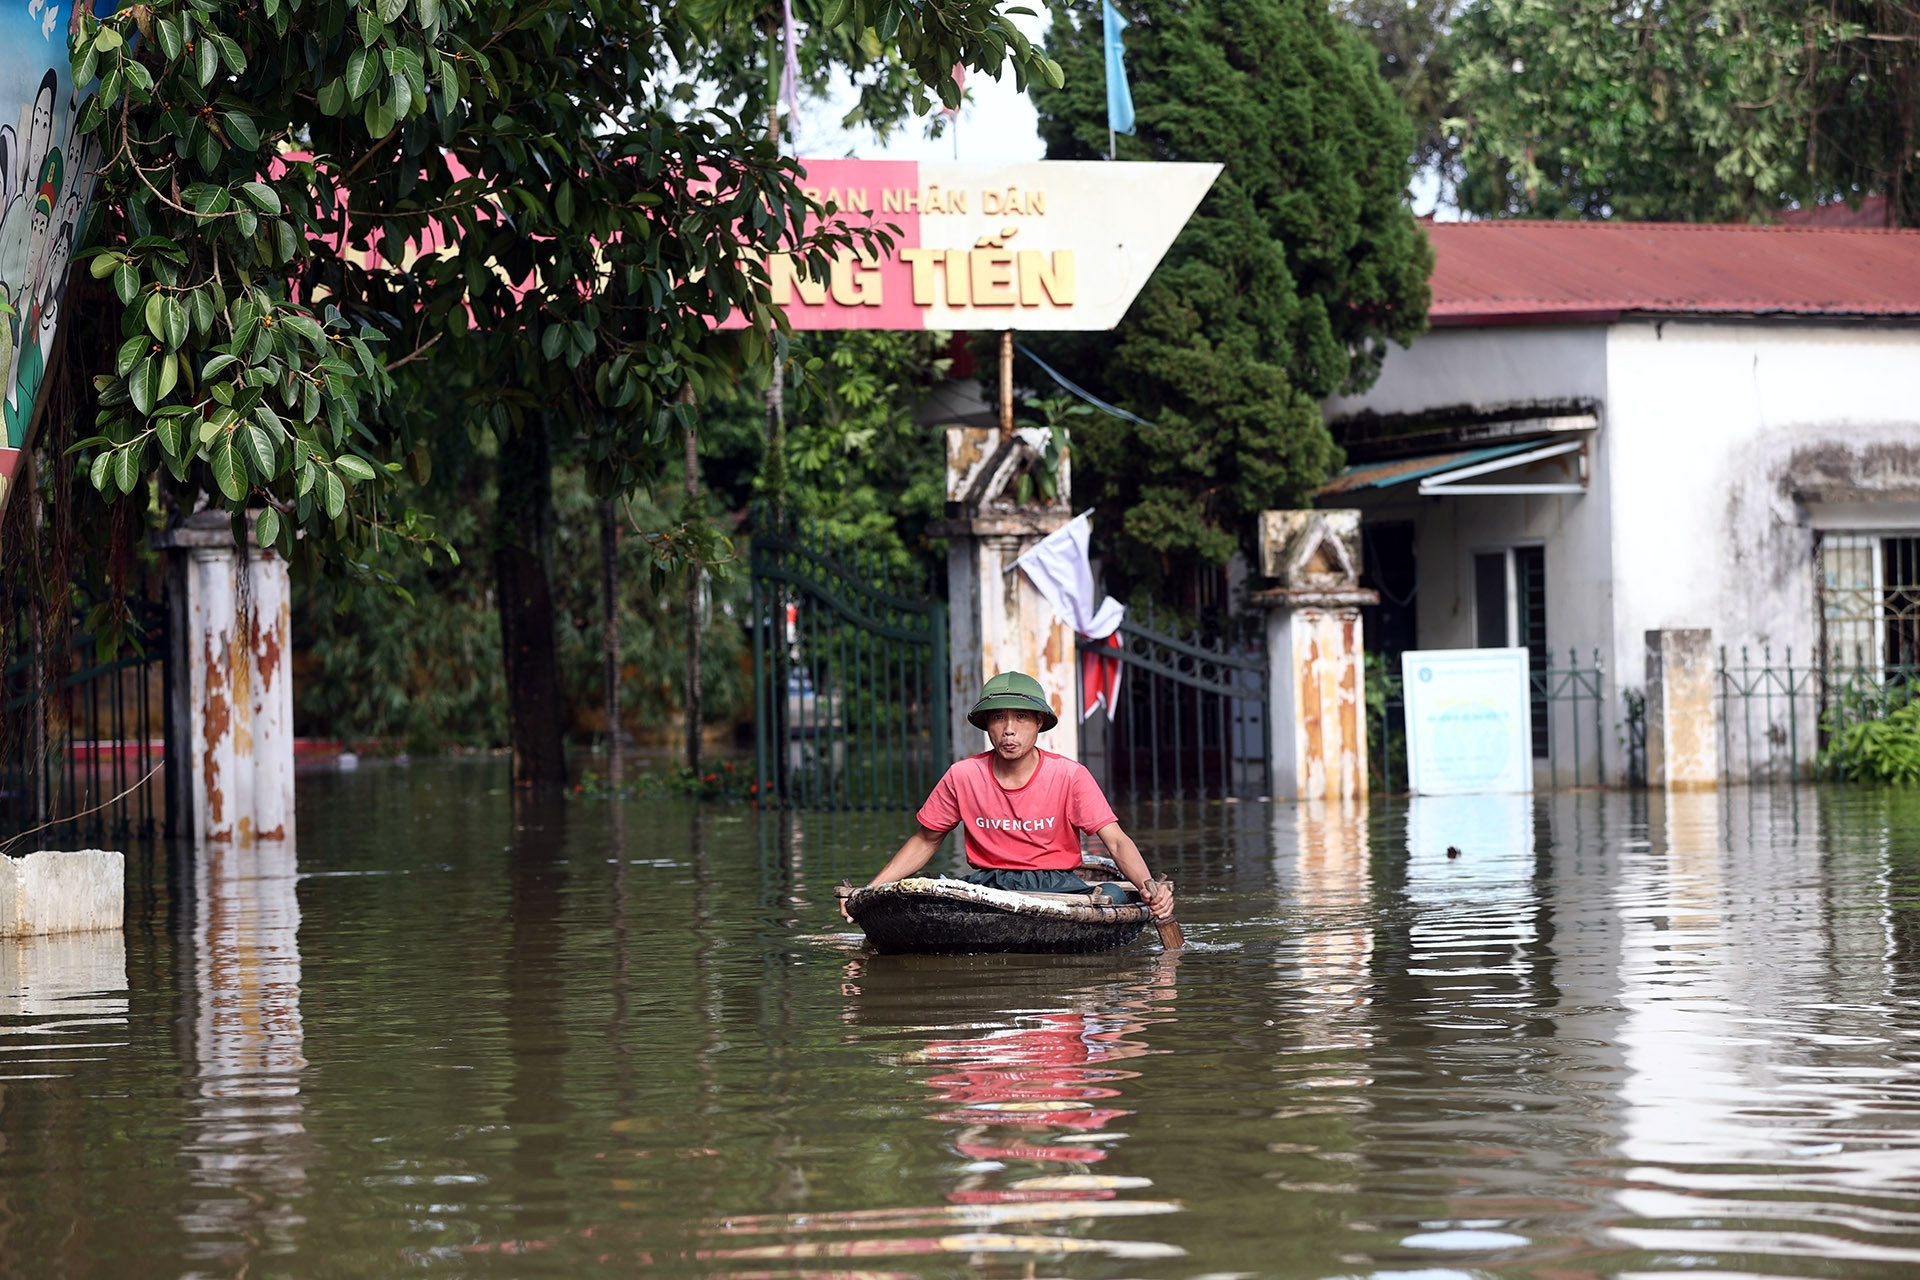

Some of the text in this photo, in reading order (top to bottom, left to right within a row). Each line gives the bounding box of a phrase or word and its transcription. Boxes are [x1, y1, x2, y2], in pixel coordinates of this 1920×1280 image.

[802, 187, 868, 214] BAN
[881, 184, 968, 215] NHÂN
[982, 185, 1046, 216] DÂN
[899, 226, 1075, 307] TIẾN
[975, 816, 1056, 832] GIVENCHY
